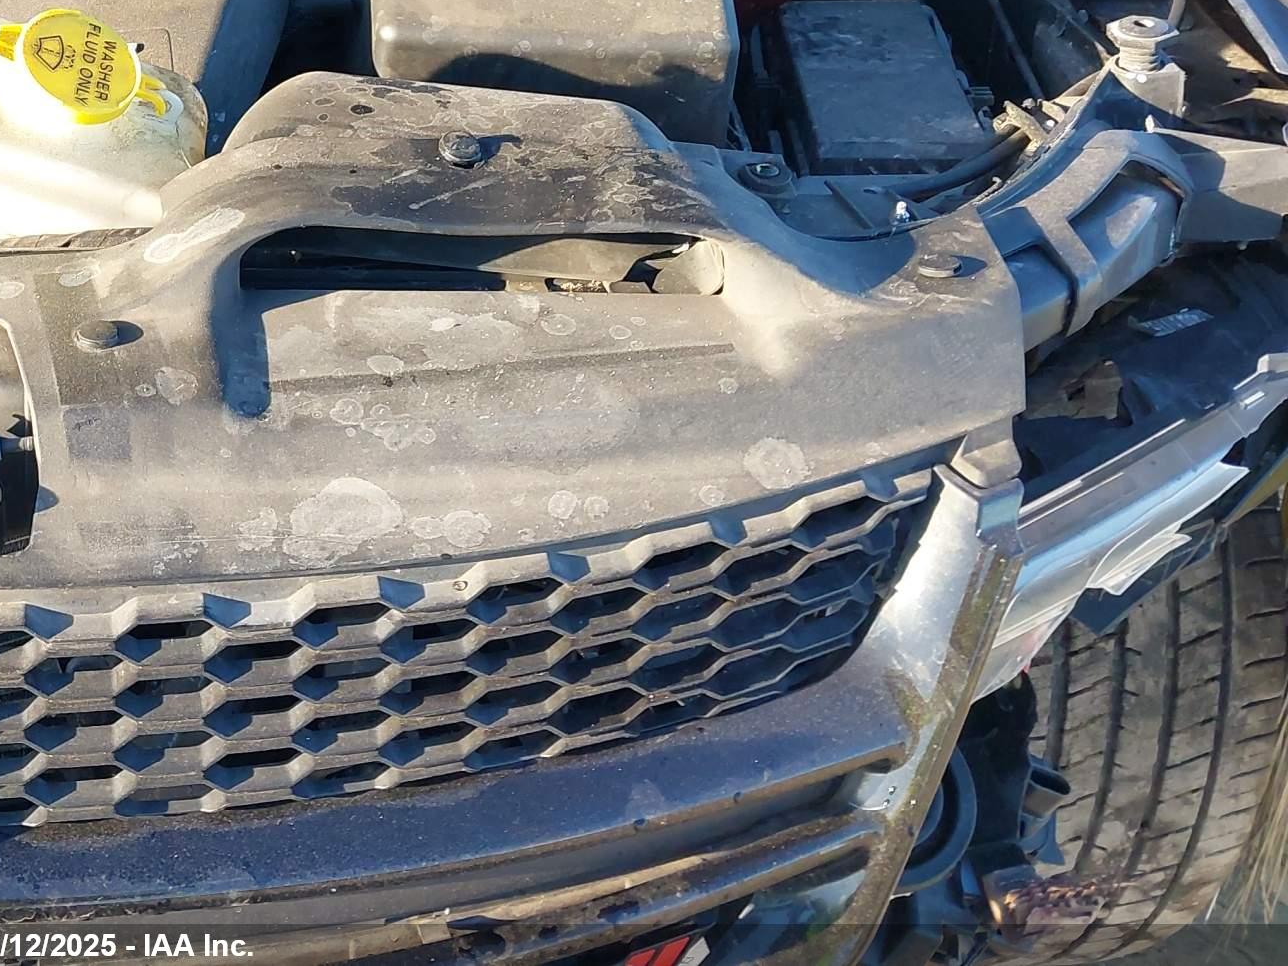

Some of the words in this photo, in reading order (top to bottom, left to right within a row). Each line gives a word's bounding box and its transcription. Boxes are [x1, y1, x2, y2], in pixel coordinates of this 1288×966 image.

[82, 23, 102, 64] FLUID
[74, 67, 94, 106] ONLY
[94, 40, 117, 101] WASHER
